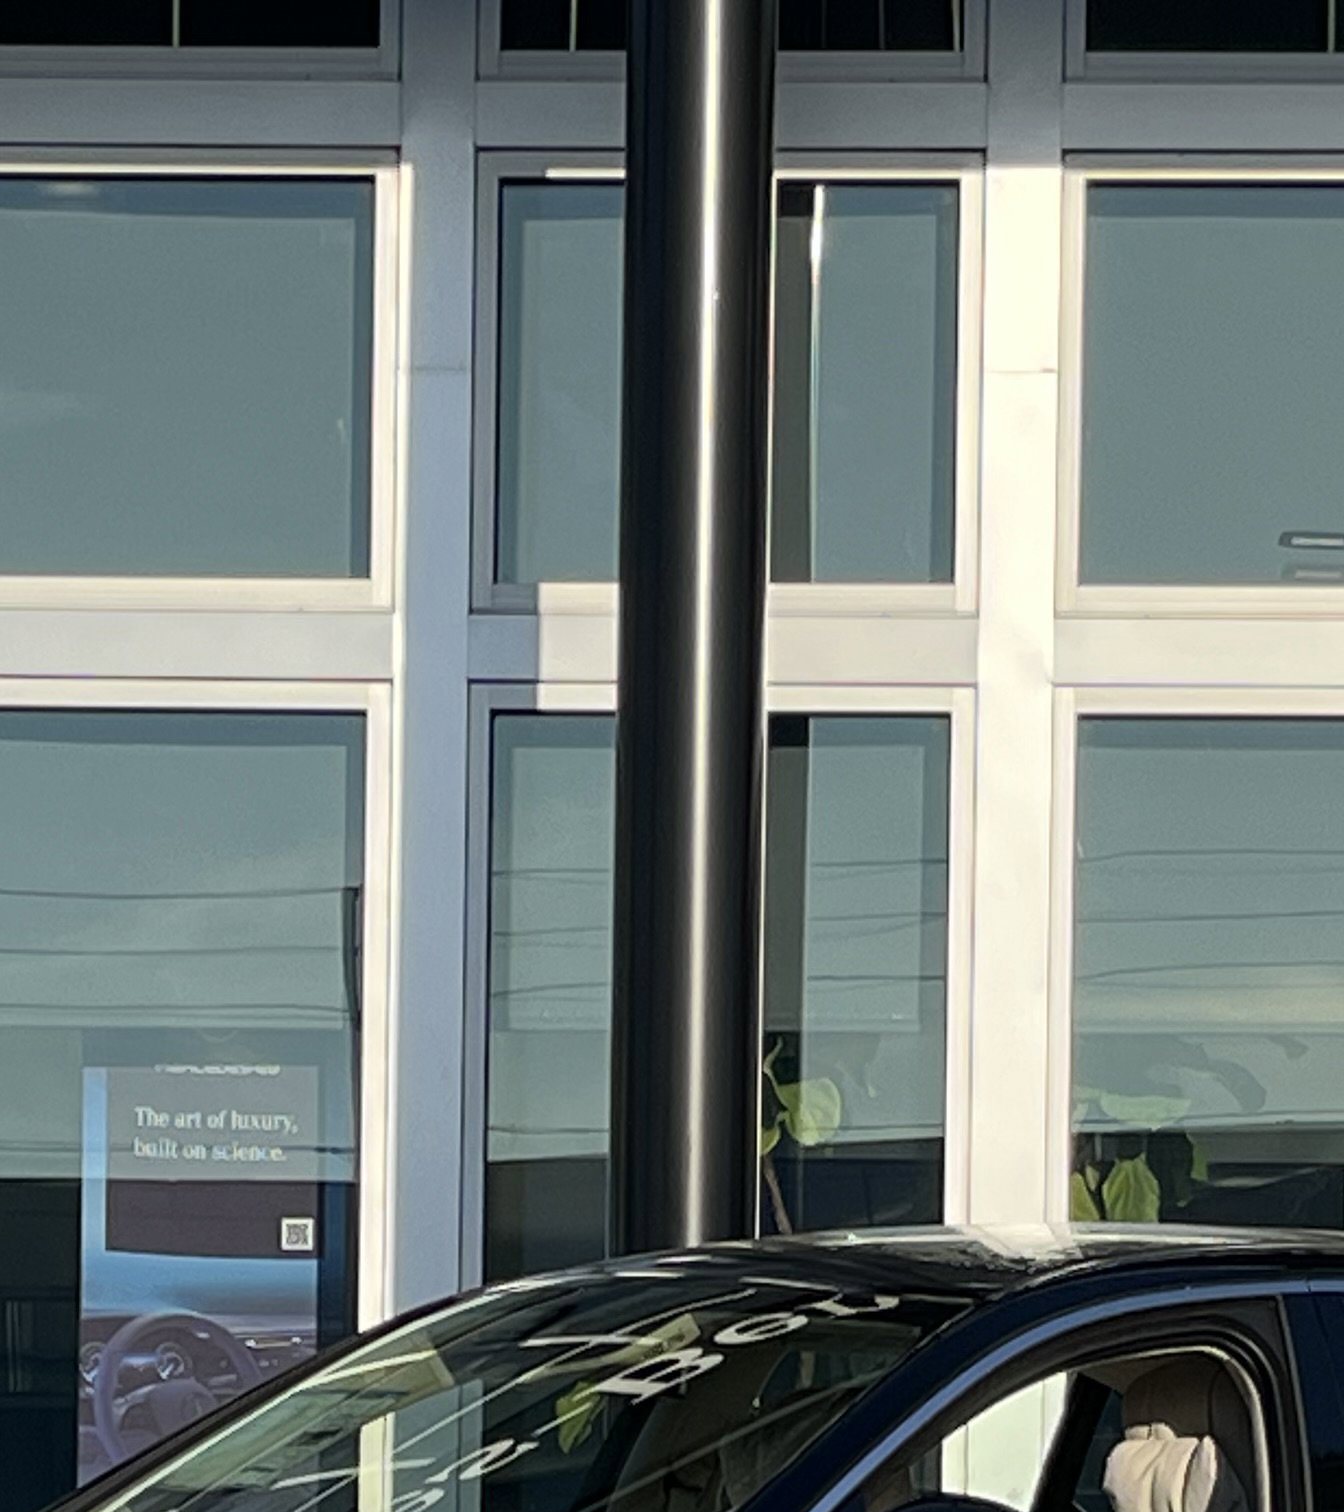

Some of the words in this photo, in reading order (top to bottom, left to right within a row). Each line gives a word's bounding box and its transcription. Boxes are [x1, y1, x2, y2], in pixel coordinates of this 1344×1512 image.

[134, 1106, 170, 1128] The
[174, 1111, 202, 1128] art
[207, 1110, 227, 1128] of
[231, 1110, 299, 1134] luxury,
[133, 1136, 178, 1159] built
[182, 1144, 206, 1160] on
[211, 1141, 287, 1161] science.
